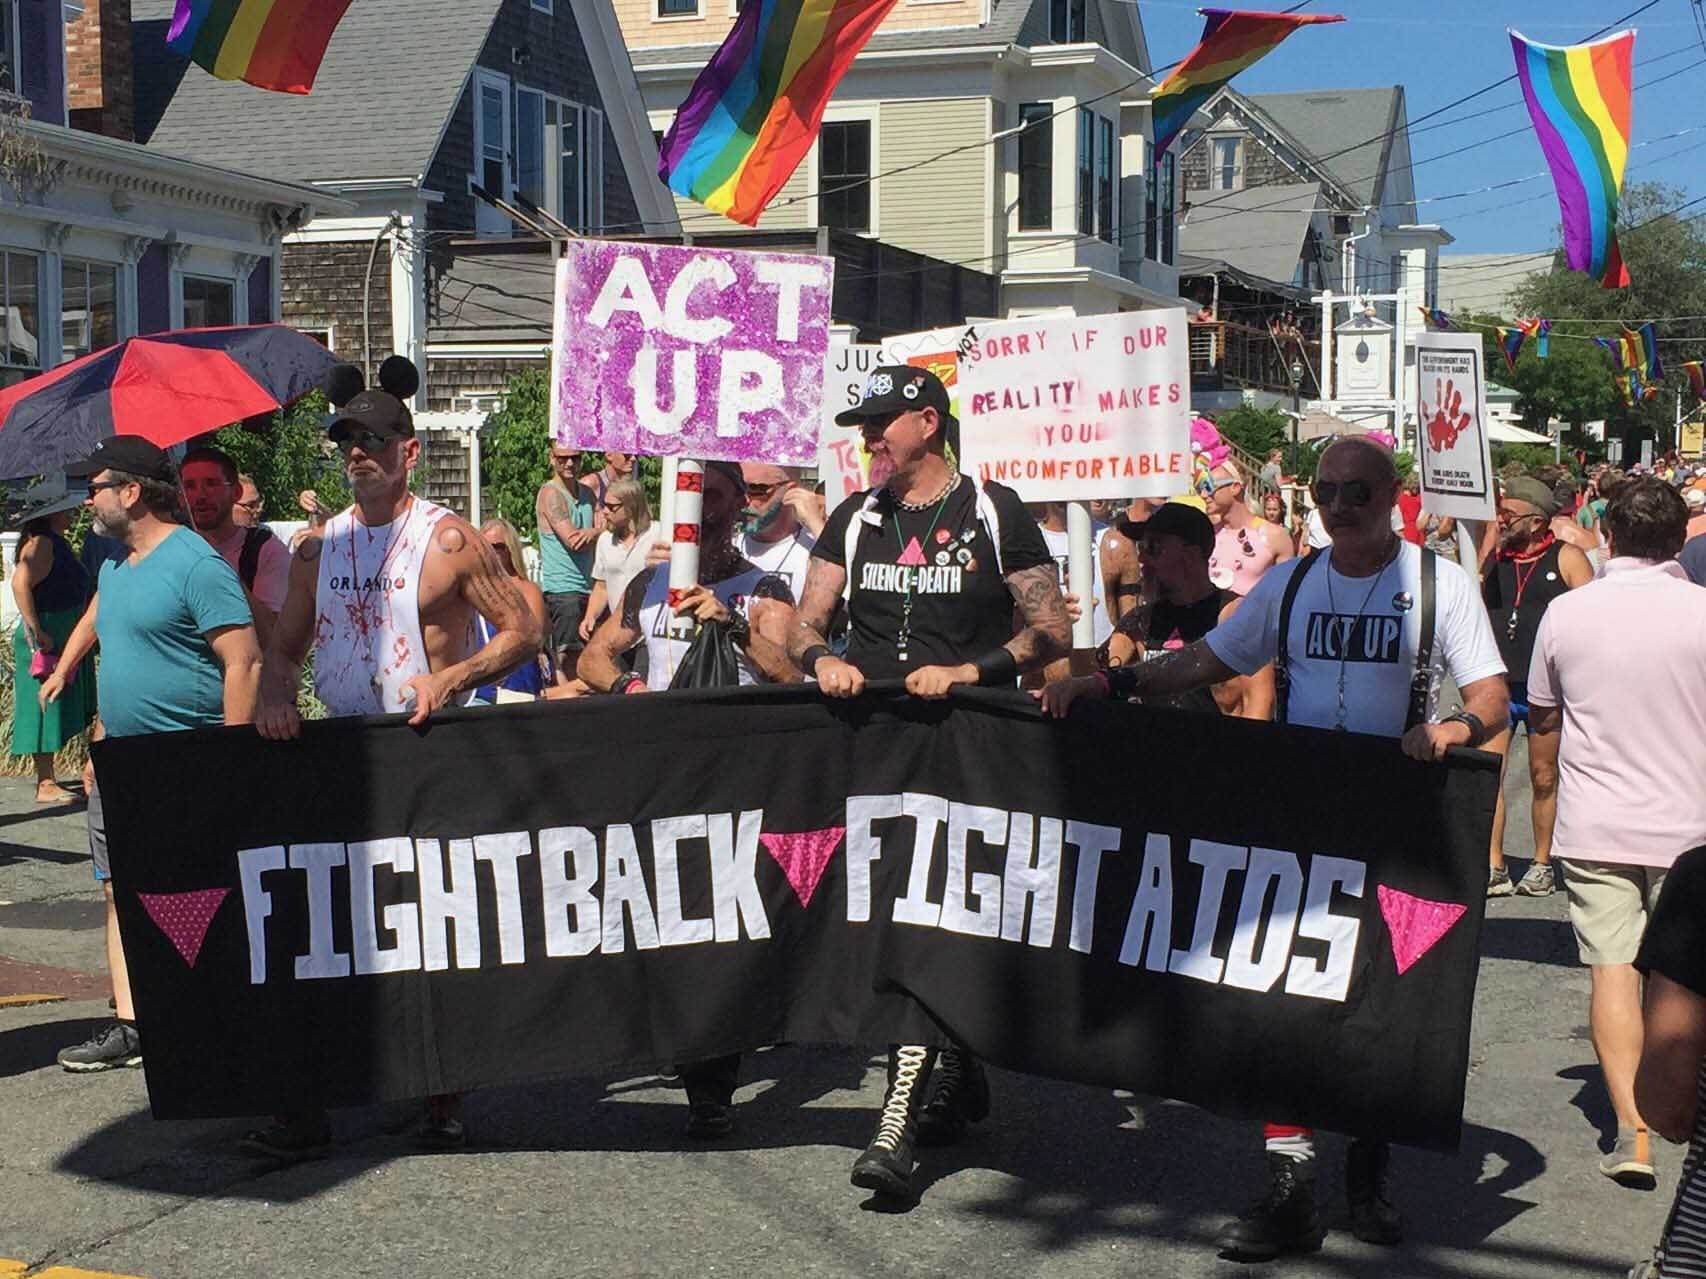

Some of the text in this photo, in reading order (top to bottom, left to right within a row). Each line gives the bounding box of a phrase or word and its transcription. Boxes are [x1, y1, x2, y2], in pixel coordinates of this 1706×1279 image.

[585, 254, 826, 344] ACT
[956, 326, 978, 363] NOT
[970, 326, 1168, 362] SORRY IF OUR
[628, 349, 785, 438] UP
[972, 381, 1181, 416] REALITY MAKES
[1044, 423, 1092, 447] YOU
[978, 453, 1182, 482] UNCOMFORTABLE
[1308, 615, 1399, 659] ACT UP
[846, 791, 1367, 1002] FIGHT AIDS
